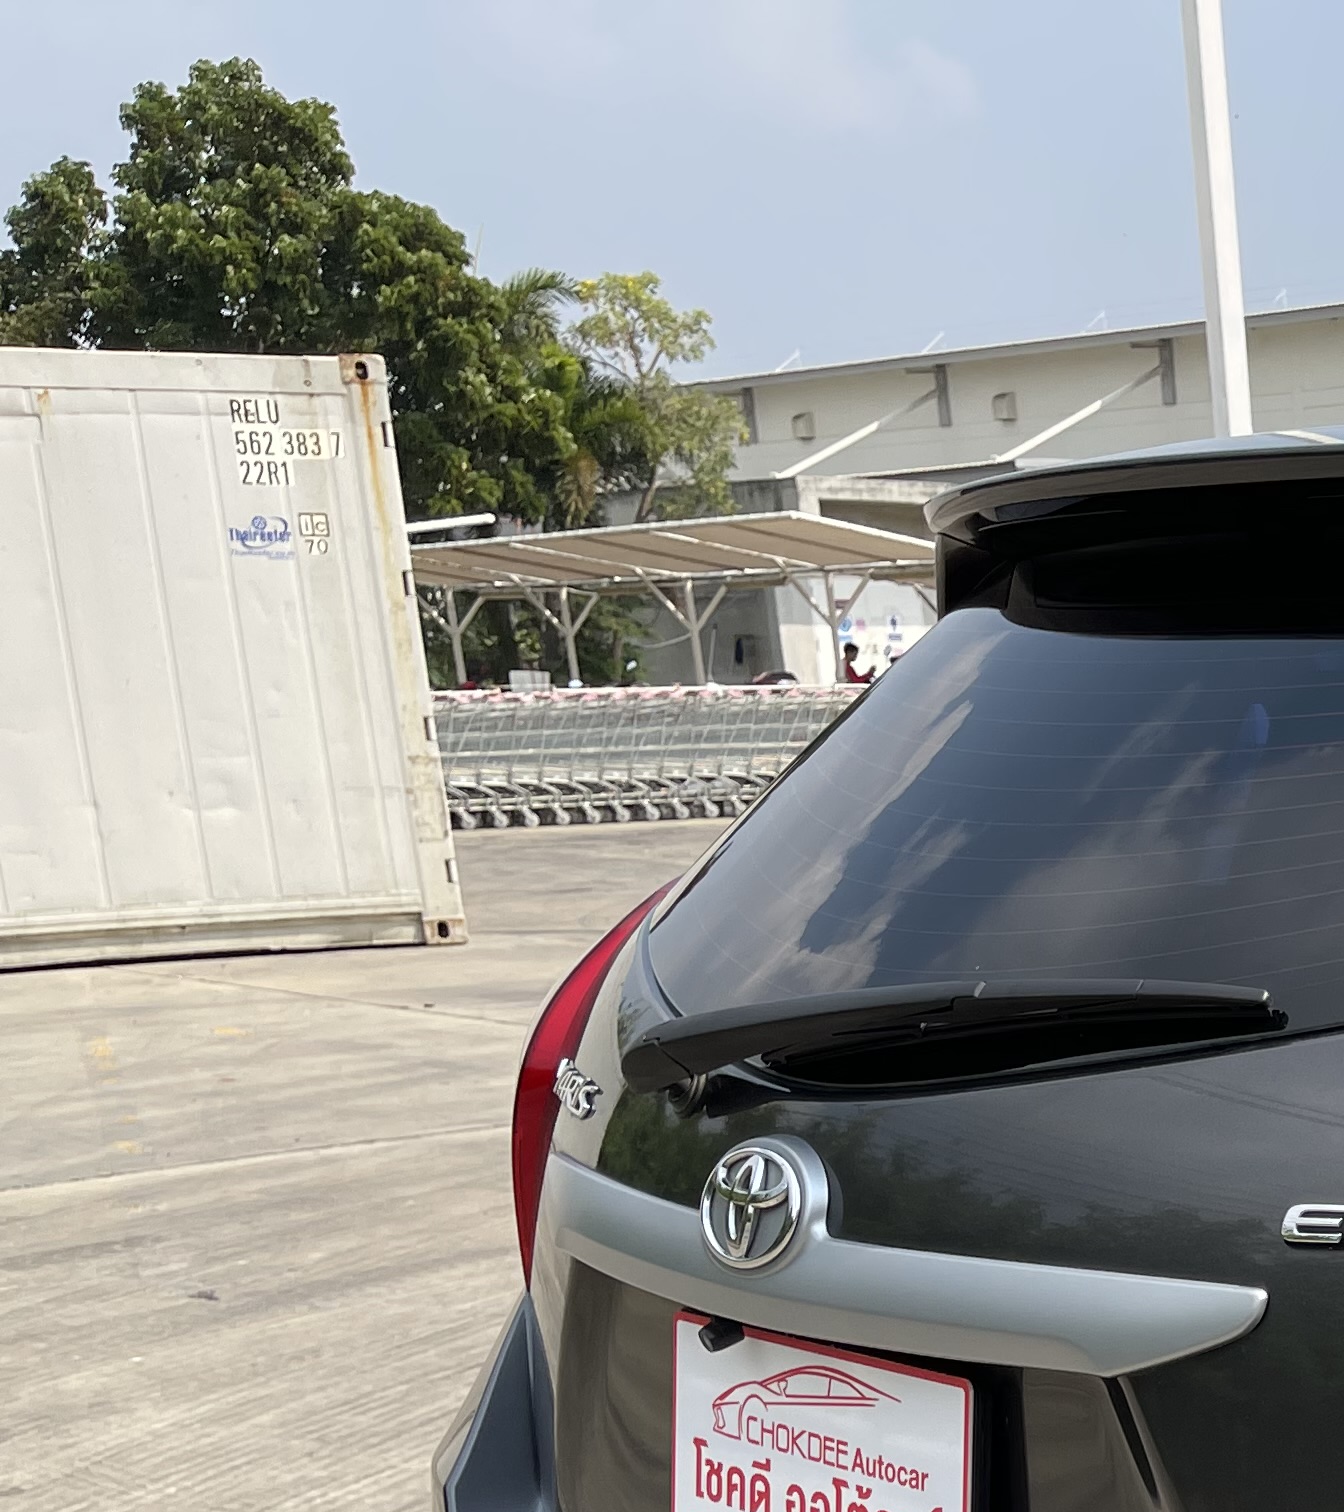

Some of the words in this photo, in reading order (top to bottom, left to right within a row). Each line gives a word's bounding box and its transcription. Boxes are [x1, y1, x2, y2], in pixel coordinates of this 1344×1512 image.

[229, 399, 280, 425] RELU
[234, 430, 275, 456] 562
[282, 431, 322, 457] 383
[330, 432, 341, 457] 7
[239, 461, 290, 487] 22R1
[305, 539, 329, 554] 70
[746, 1416, 850, 1470] CHOKDEE
[851, 1447, 929, 1492] Autocar
